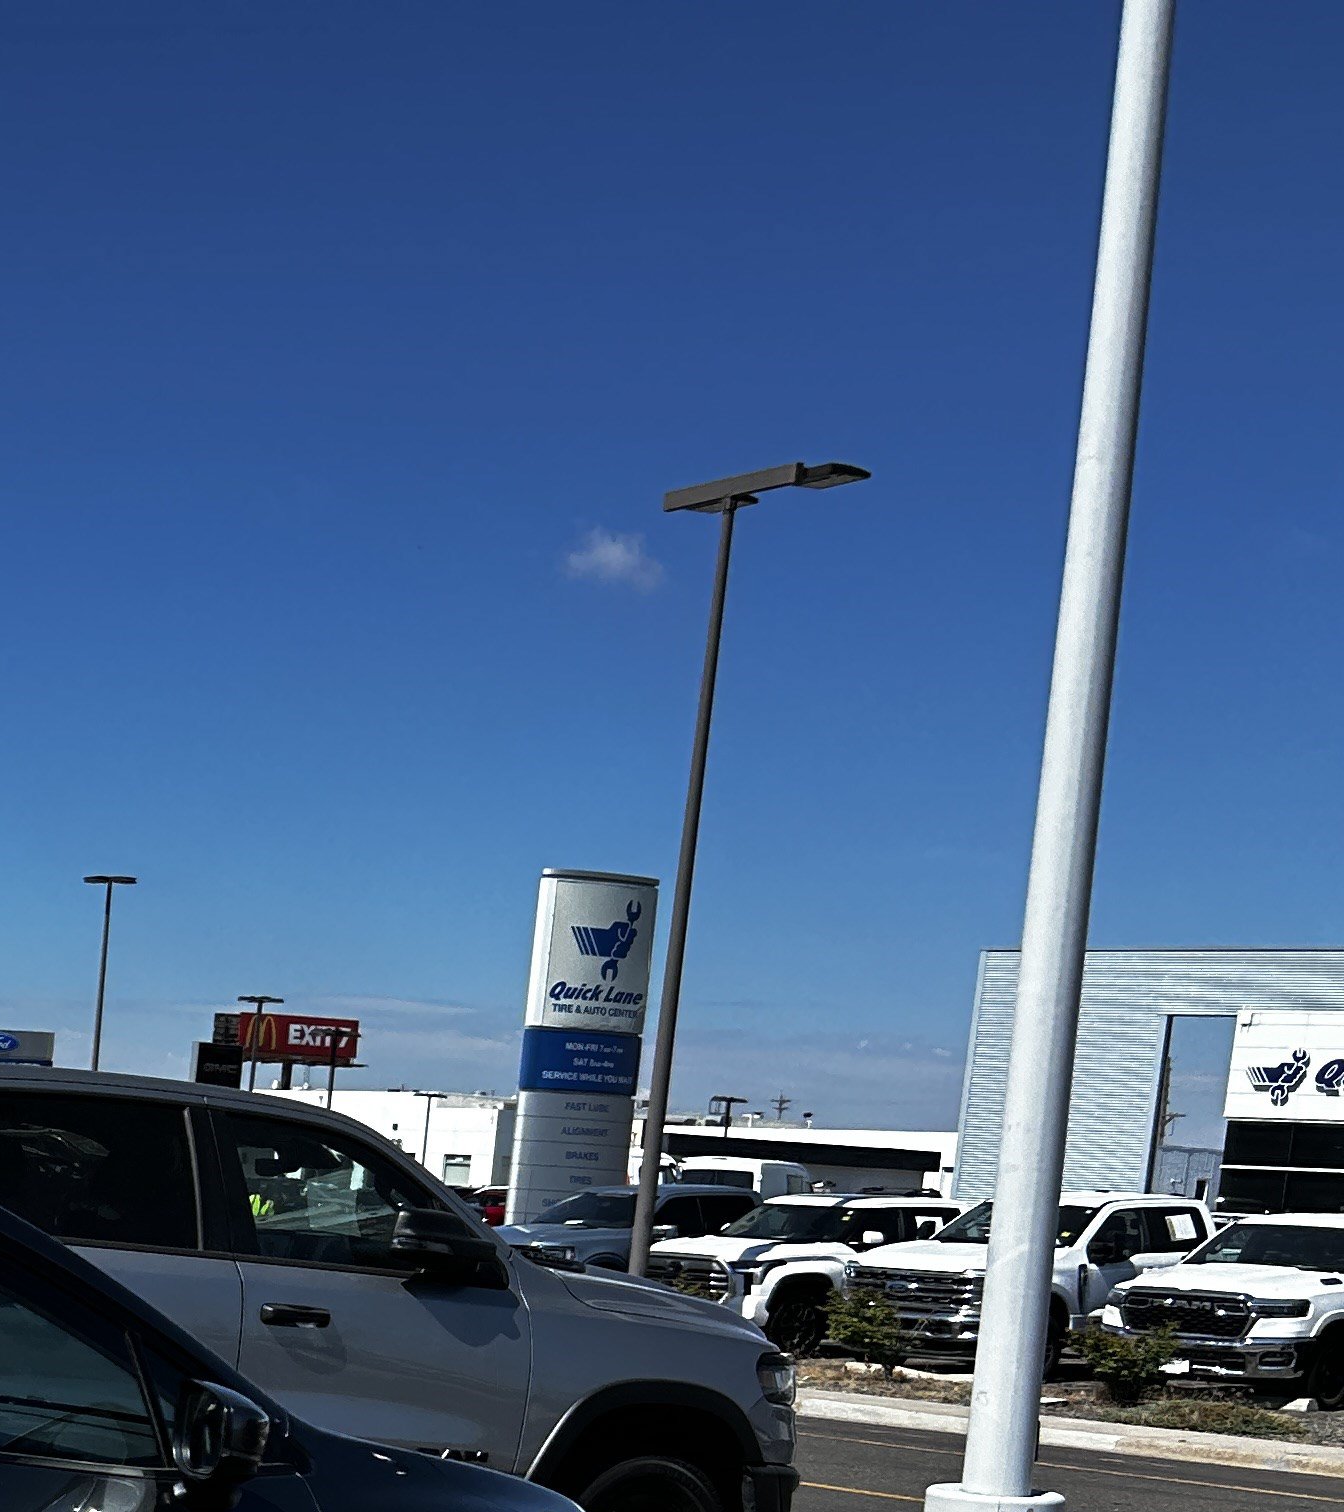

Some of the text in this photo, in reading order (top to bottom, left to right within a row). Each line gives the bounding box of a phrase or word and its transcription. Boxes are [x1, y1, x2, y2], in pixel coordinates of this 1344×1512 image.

[549, 981, 643, 1005] Quick Lane
[552, 1003, 638, 1019] TIRE & AUTO CENTER
[287, 1023, 335, 1048] EXIT
[541, 1070, 578, 1081] SERVICE
[565, 1102, 587, 1112] FAST
[565, 1151, 599, 1161] BRAKES
